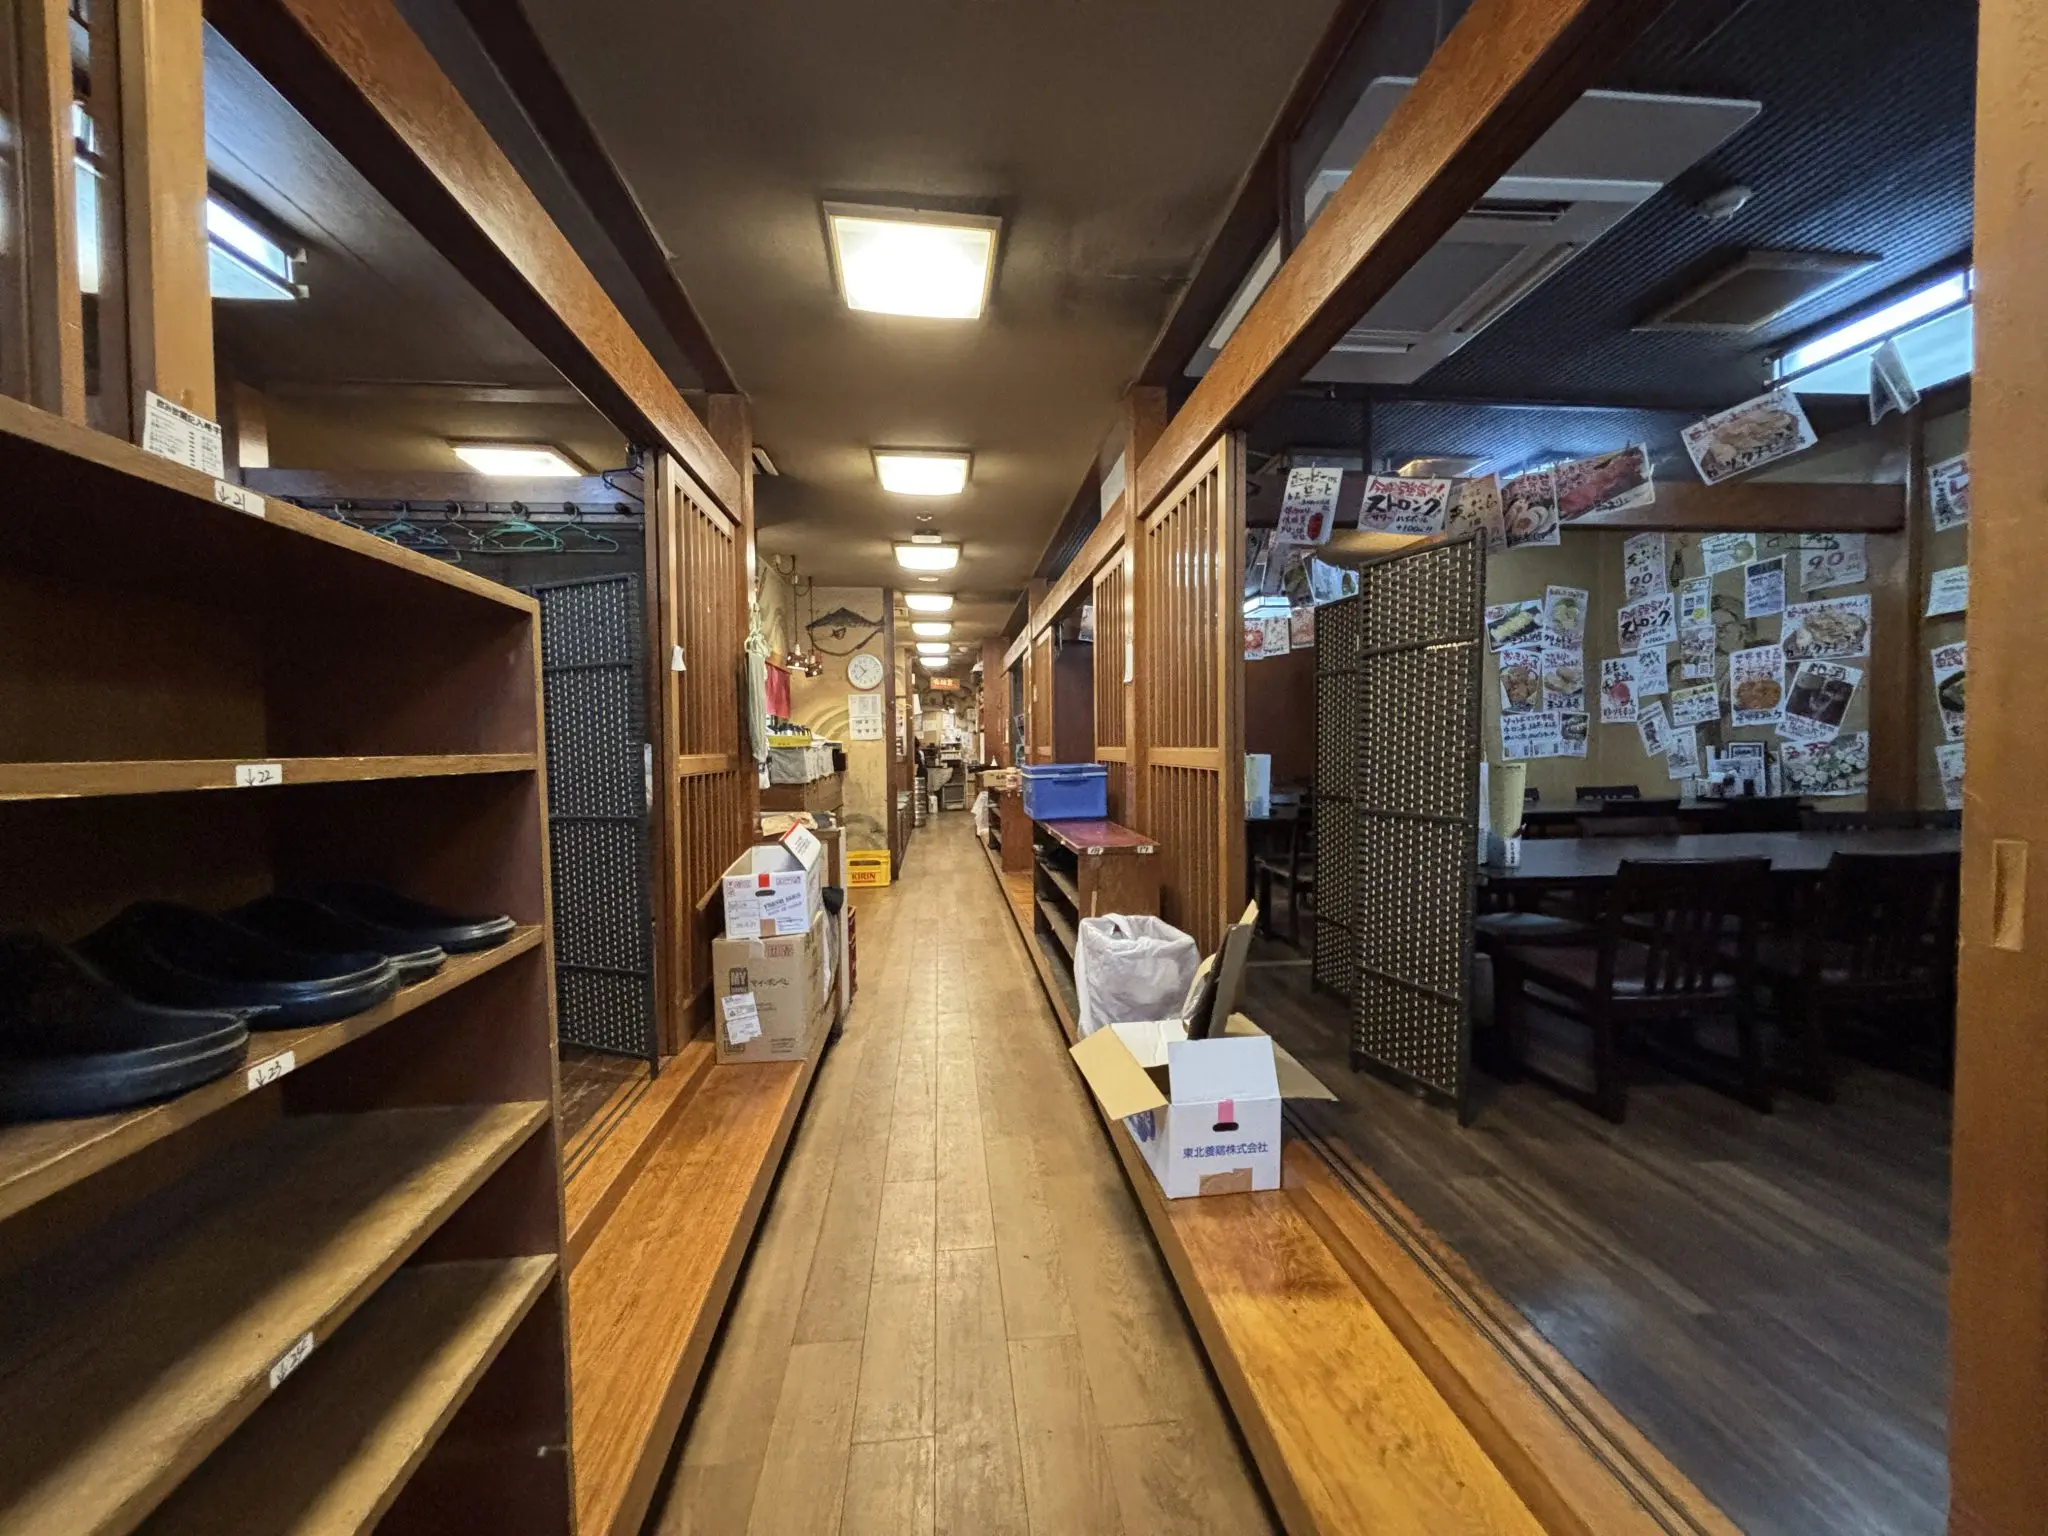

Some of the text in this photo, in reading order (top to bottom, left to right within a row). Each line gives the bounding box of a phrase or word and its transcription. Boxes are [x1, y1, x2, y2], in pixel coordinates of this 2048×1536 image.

[1366, 493, 1444, 517] ストロング
[258, 769, 274, 783] 22
[851, 871, 876, 880] KIRIN
[268, 1060, 282, 1081] 23
